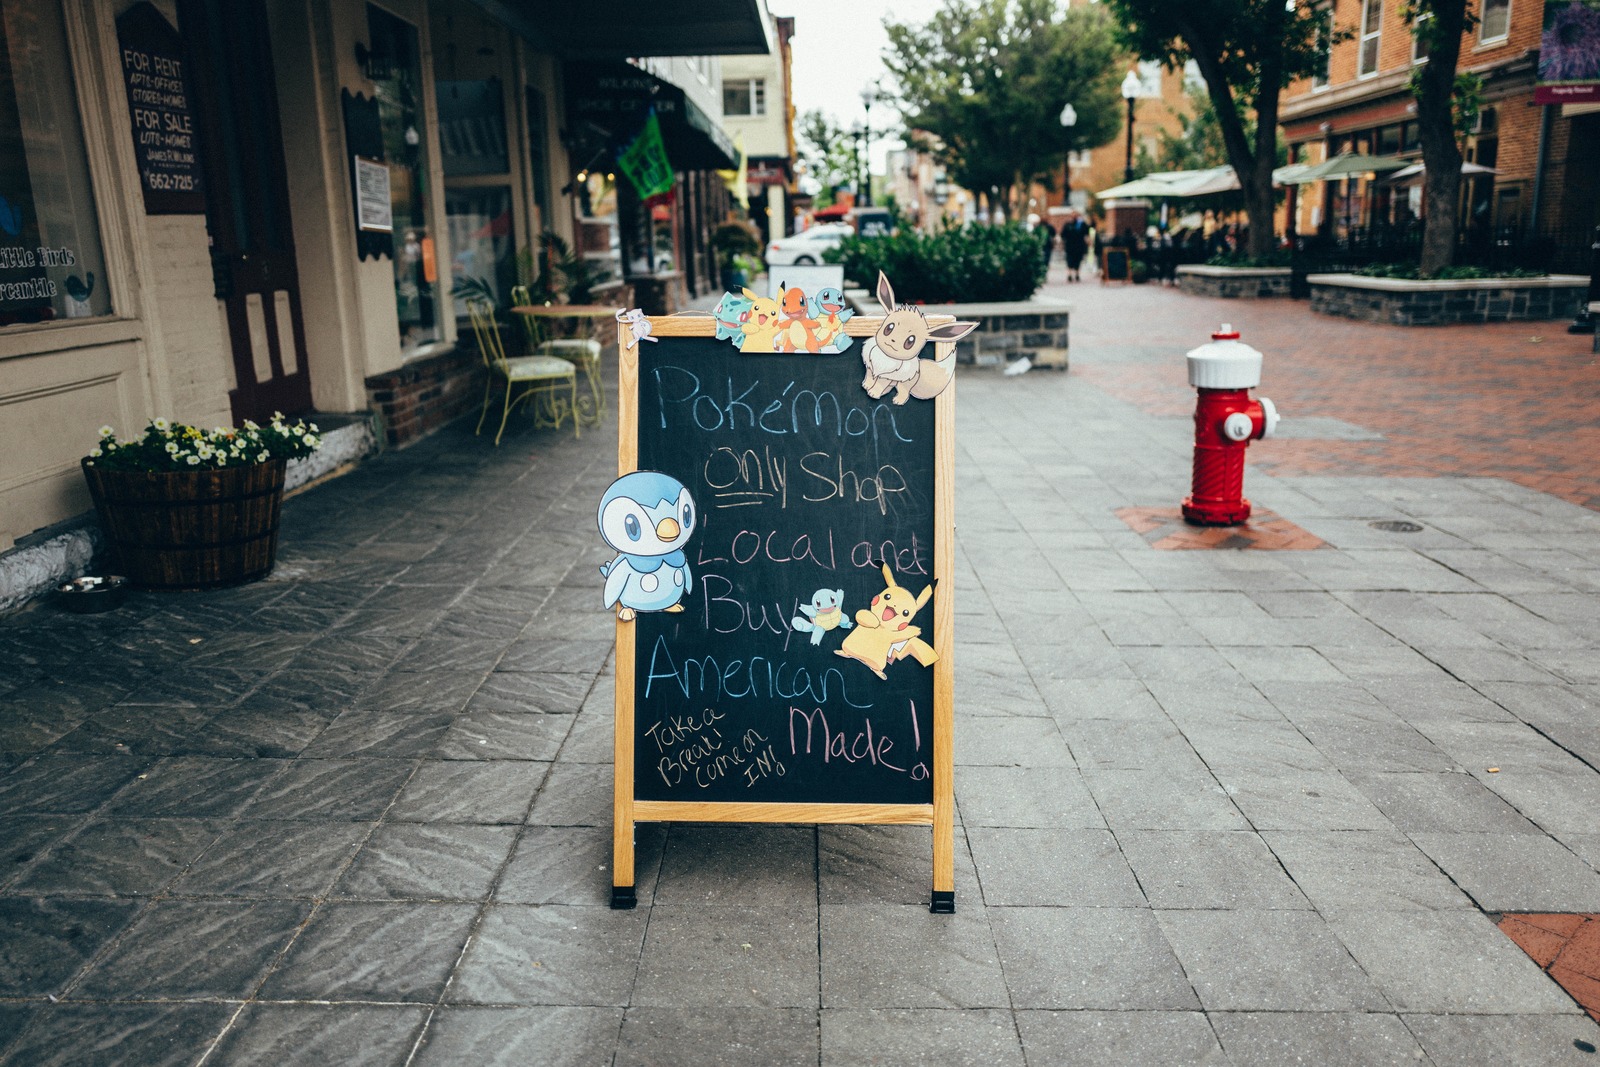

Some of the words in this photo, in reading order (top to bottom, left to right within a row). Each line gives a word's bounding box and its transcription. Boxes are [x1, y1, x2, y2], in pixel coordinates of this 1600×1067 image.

[124, 50, 150, 72] FOR
[154, 56, 180, 78] RENT
[135, 109, 160, 130] FOR
[164, 113, 193, 134] SALE
[0, 247, 35, 268] ittle
[37, 246, 75, 267] Birds
[704, 445, 786, 509] Only
[800, 451, 906, 515] Shop
[698, 514, 835, 570] Local
[851, 531, 928, 575] and
[701, 574, 798, 651] Buy
[645, 634, 874, 708] American
[645, 715, 703, 753] Take
[702, 708, 726, 726] a
